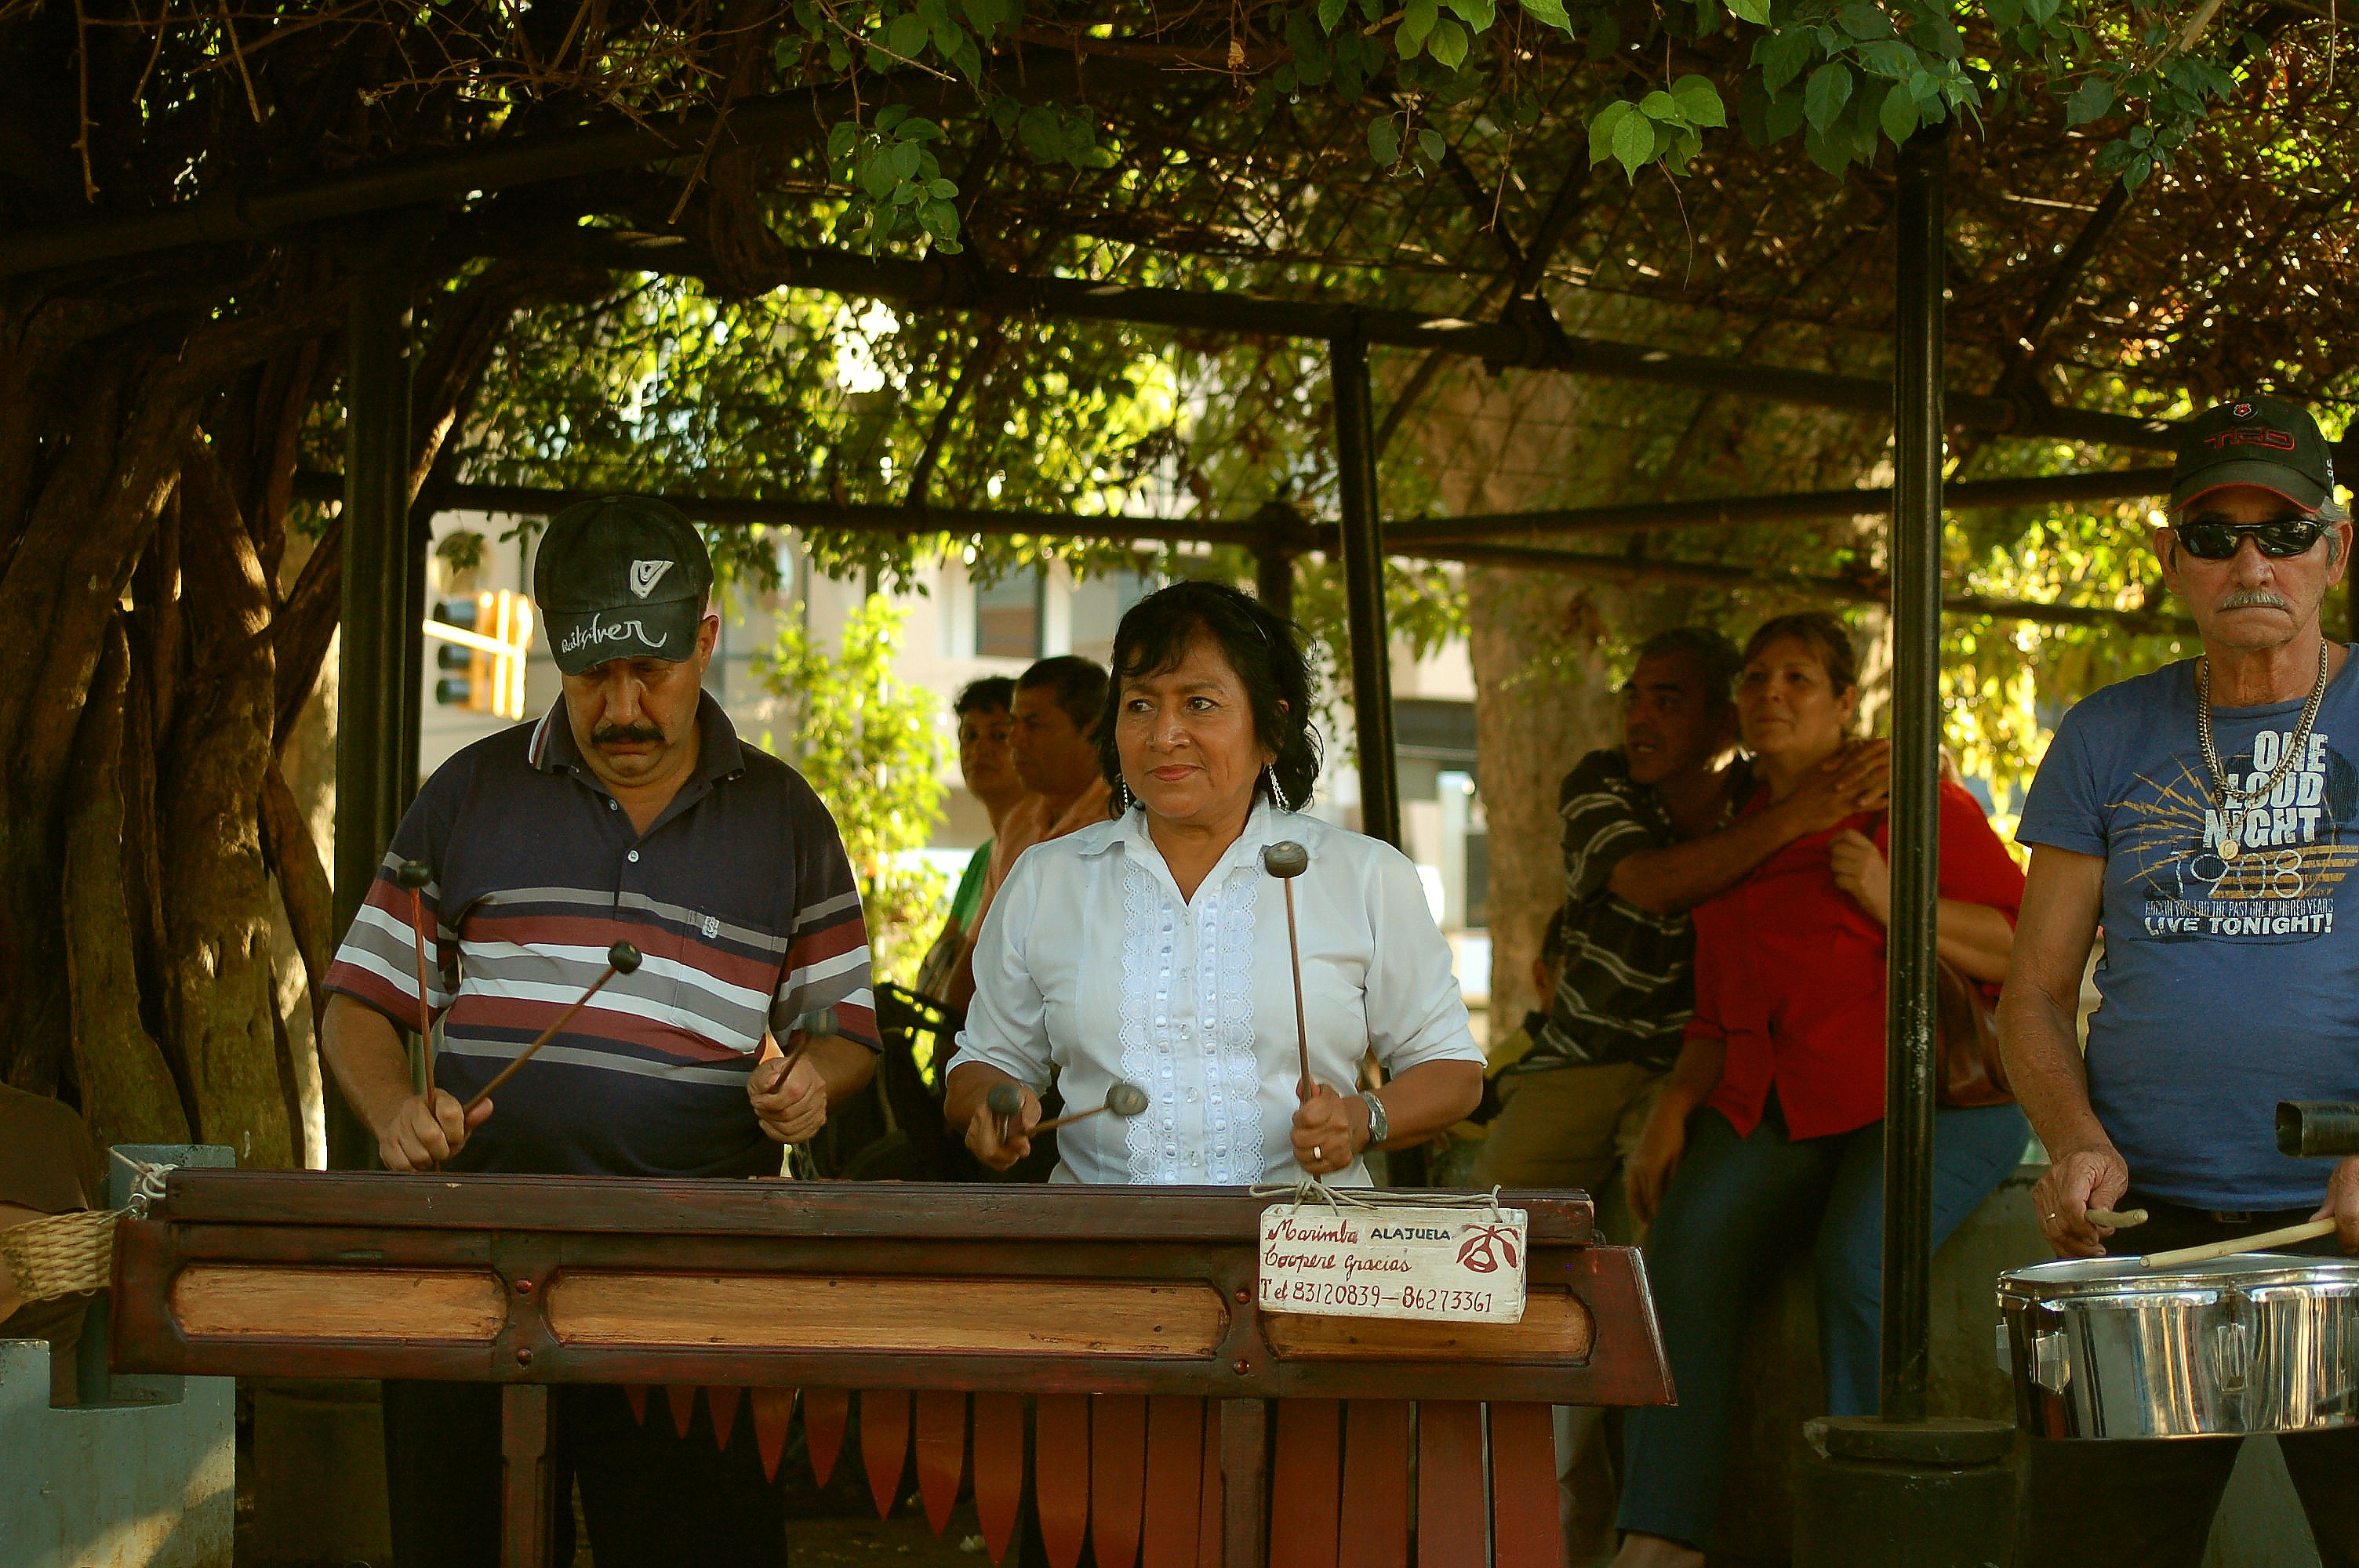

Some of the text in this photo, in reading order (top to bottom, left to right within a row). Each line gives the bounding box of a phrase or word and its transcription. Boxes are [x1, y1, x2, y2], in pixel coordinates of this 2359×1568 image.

[2253, 730, 2328, 773] ONE
[2223, 771, 2324, 809] LOUD
[2202, 808, 2321, 848] NIGHT
[2212, 901, 2226, 917] THE
[2229, 901, 2248, 916] PAST
[2144, 913, 2333, 936] LIVE TONIGHT!
[1265, 1218, 1451, 1244] Marimba ALAJUELA
[1263, 1243, 1336, 1269] Coopere
